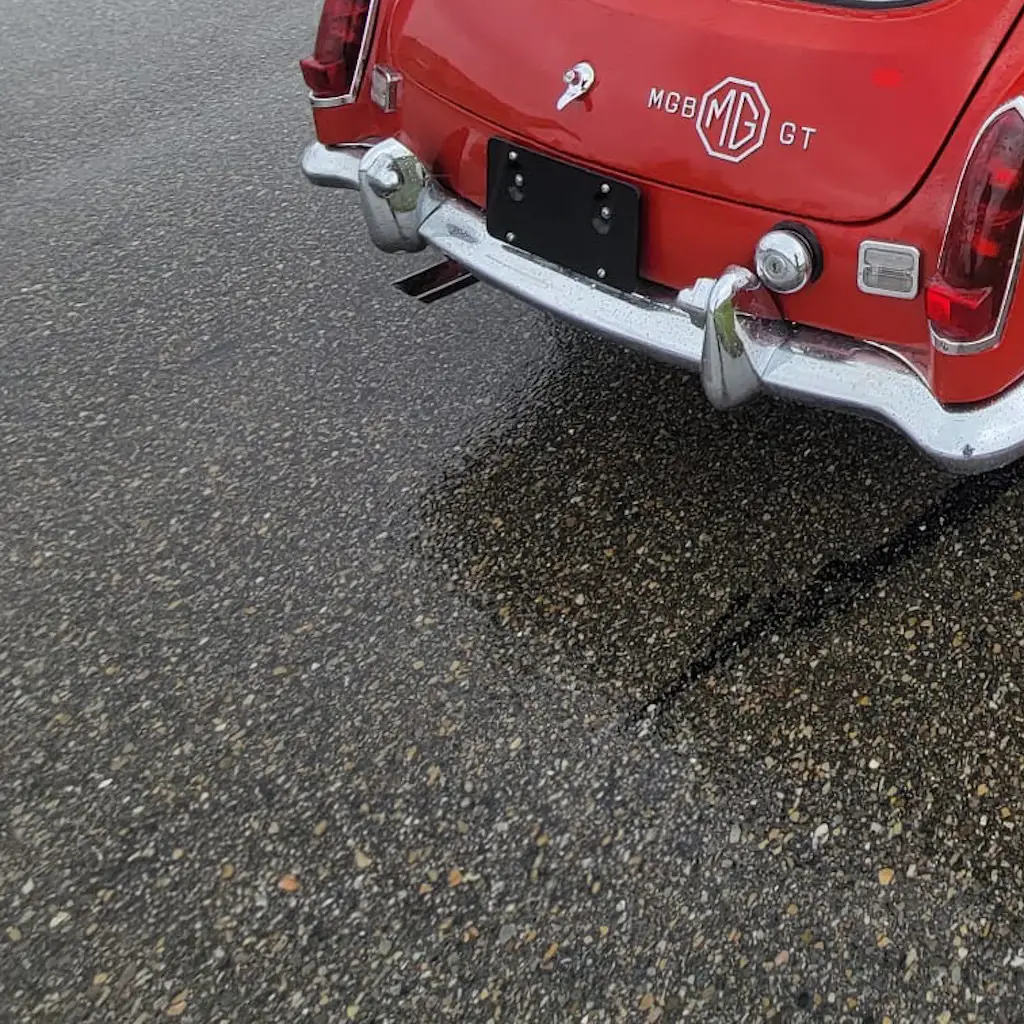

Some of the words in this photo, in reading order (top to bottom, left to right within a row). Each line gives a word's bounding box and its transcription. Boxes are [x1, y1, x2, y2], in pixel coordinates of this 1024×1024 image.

[647, 87, 697, 119] MGB
[703, 87, 761, 151] MG
[779, 121, 816, 150] GT
